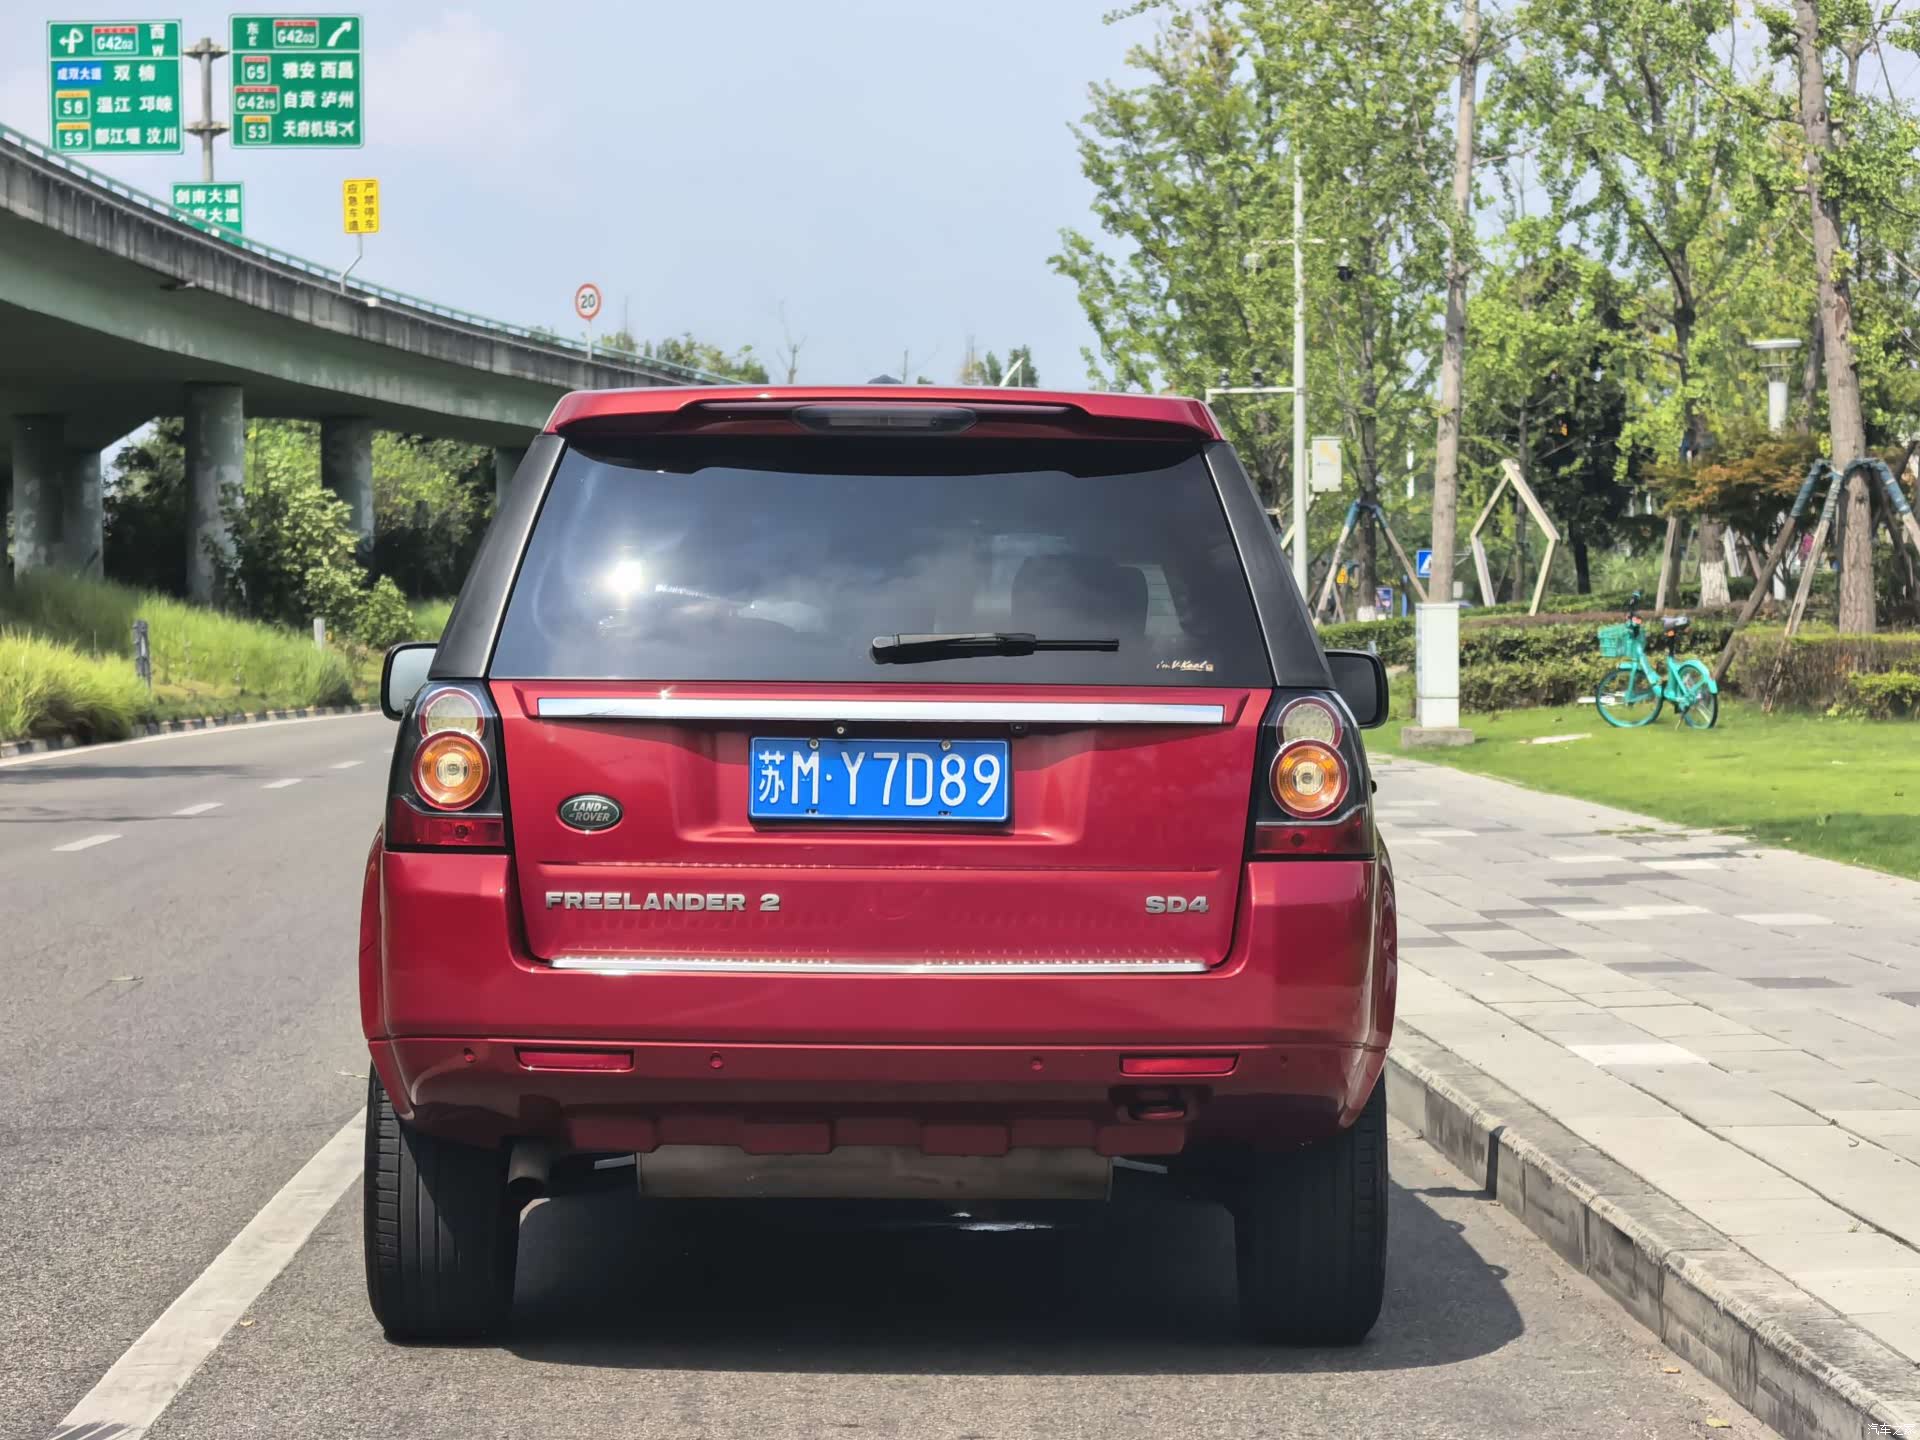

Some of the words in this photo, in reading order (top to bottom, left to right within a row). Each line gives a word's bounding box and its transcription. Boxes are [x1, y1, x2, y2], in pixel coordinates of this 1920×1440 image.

[97, 36, 133, 50] G4202
[248, 35, 257, 46] E
[278, 30, 315, 43] G4202
[152, 44, 164, 56] W
[246, 65, 266, 79] G5
[282, 61, 316, 79] 雅安
[320, 61, 353, 79] 西昌
[63, 101, 83, 114] S8
[96, 96, 131, 113] 温江
[284, 90, 316, 109] 自贡
[321, 91, 354, 108] 泸州
[95, 127, 140, 145] 都江堰
[146, 127, 177, 144] 汶川
[248, 125, 267, 139] S3
[282, 120, 338, 137] 天府机场
[64, 132, 84, 146] S9
[176, 188, 239, 204] 剑南大道
[348, 183, 358, 231] 应急车道
[364, 182, 375, 228] 严禁停车
[581, 293, 595, 309] 20
[546, 892, 746, 911] FREELANDER
[760, 893, 780, 911] 2
[1145, 895, 1209, 913] SD4
